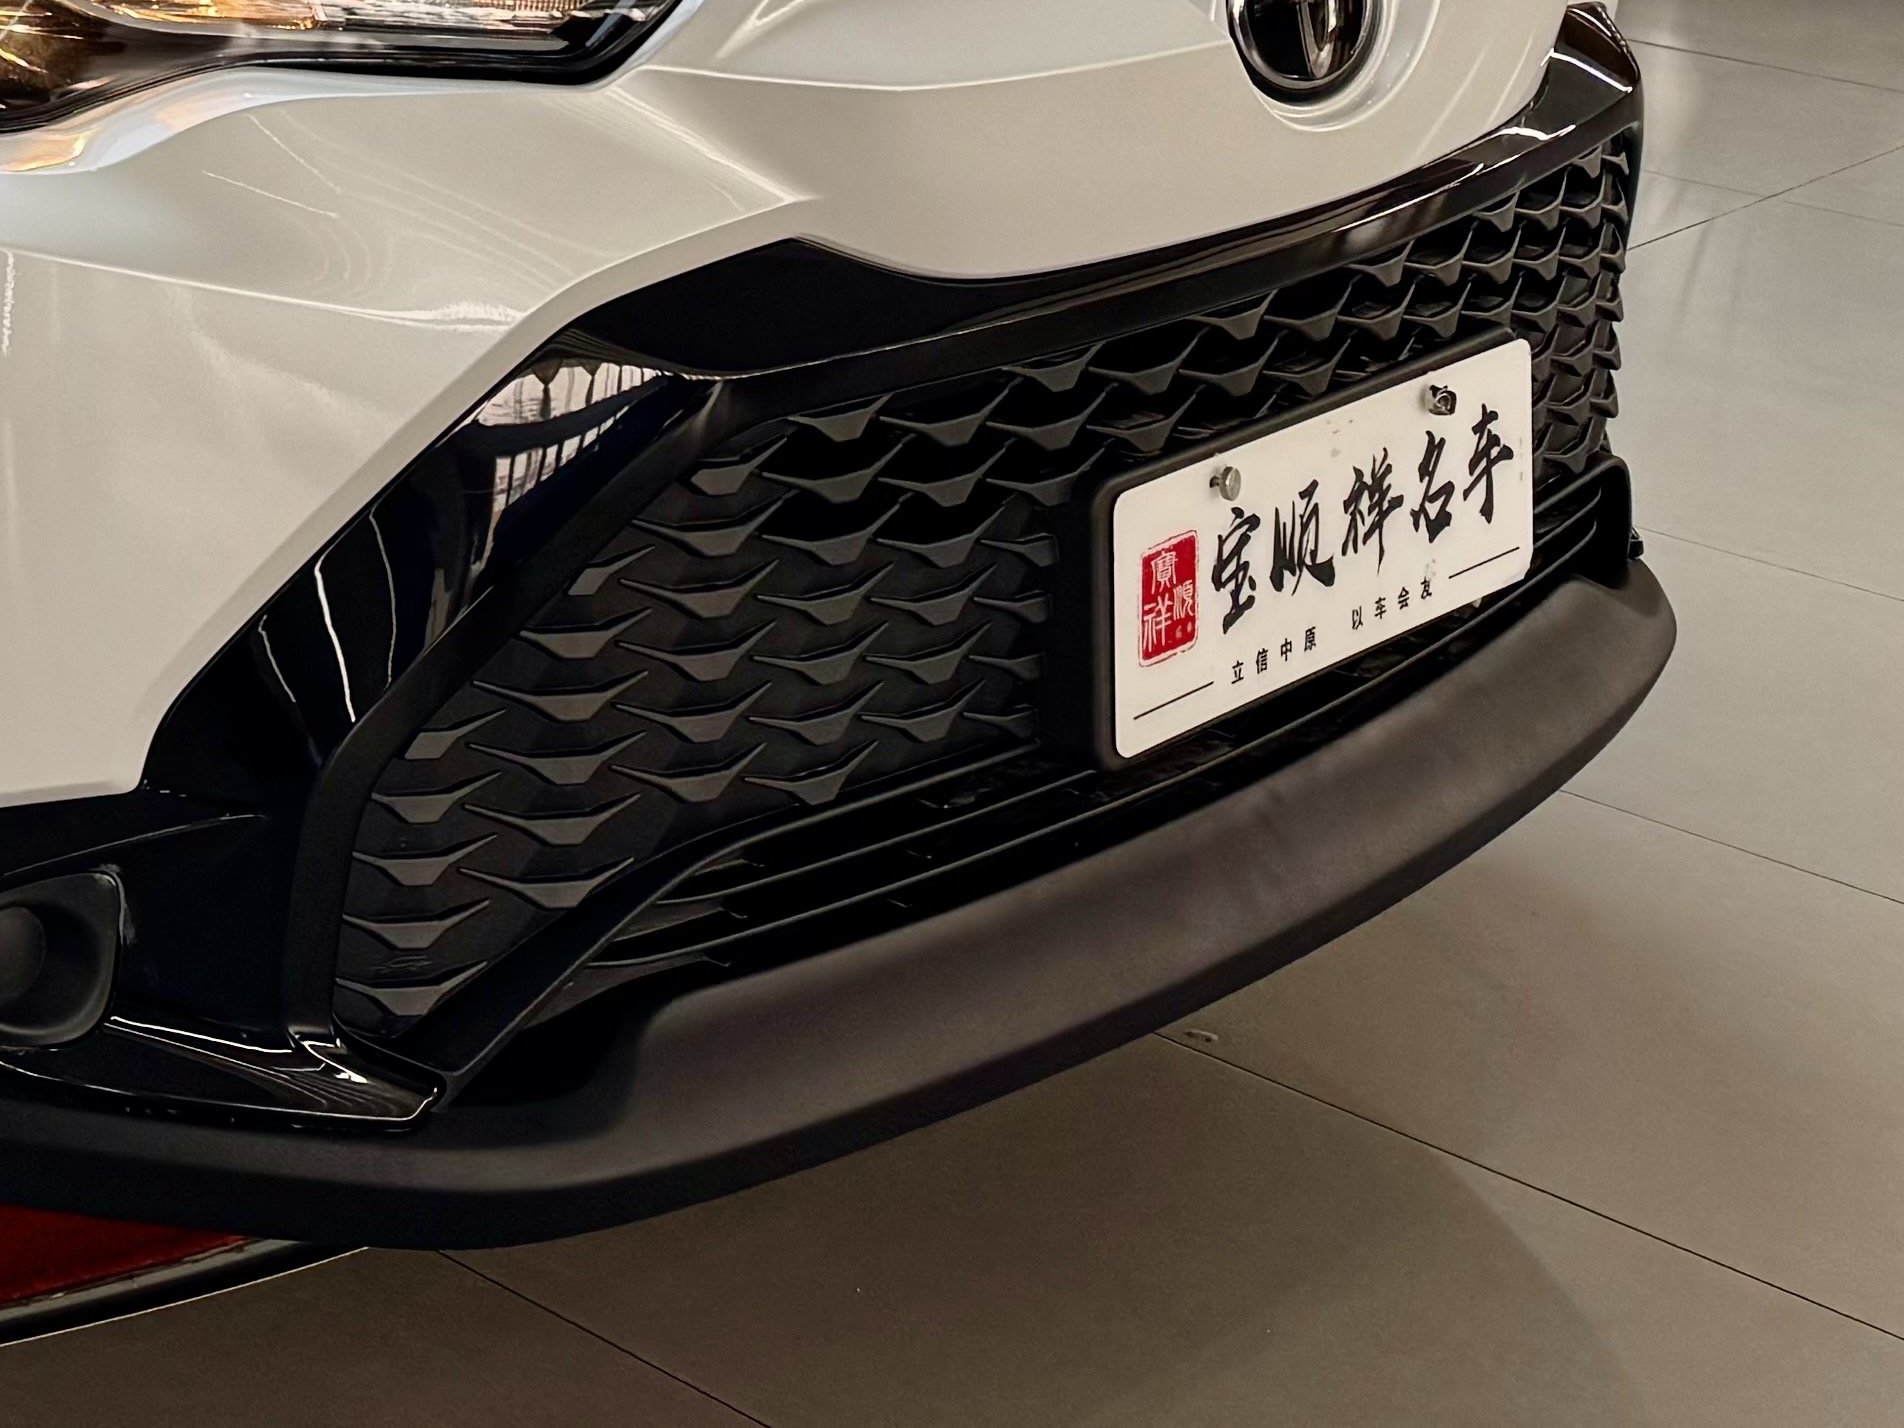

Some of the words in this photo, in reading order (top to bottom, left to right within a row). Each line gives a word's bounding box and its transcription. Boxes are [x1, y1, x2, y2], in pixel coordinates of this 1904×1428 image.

[1230, 625, 1317, 685] 立信中原
[1350, 577, 1433, 631] 以车会友
